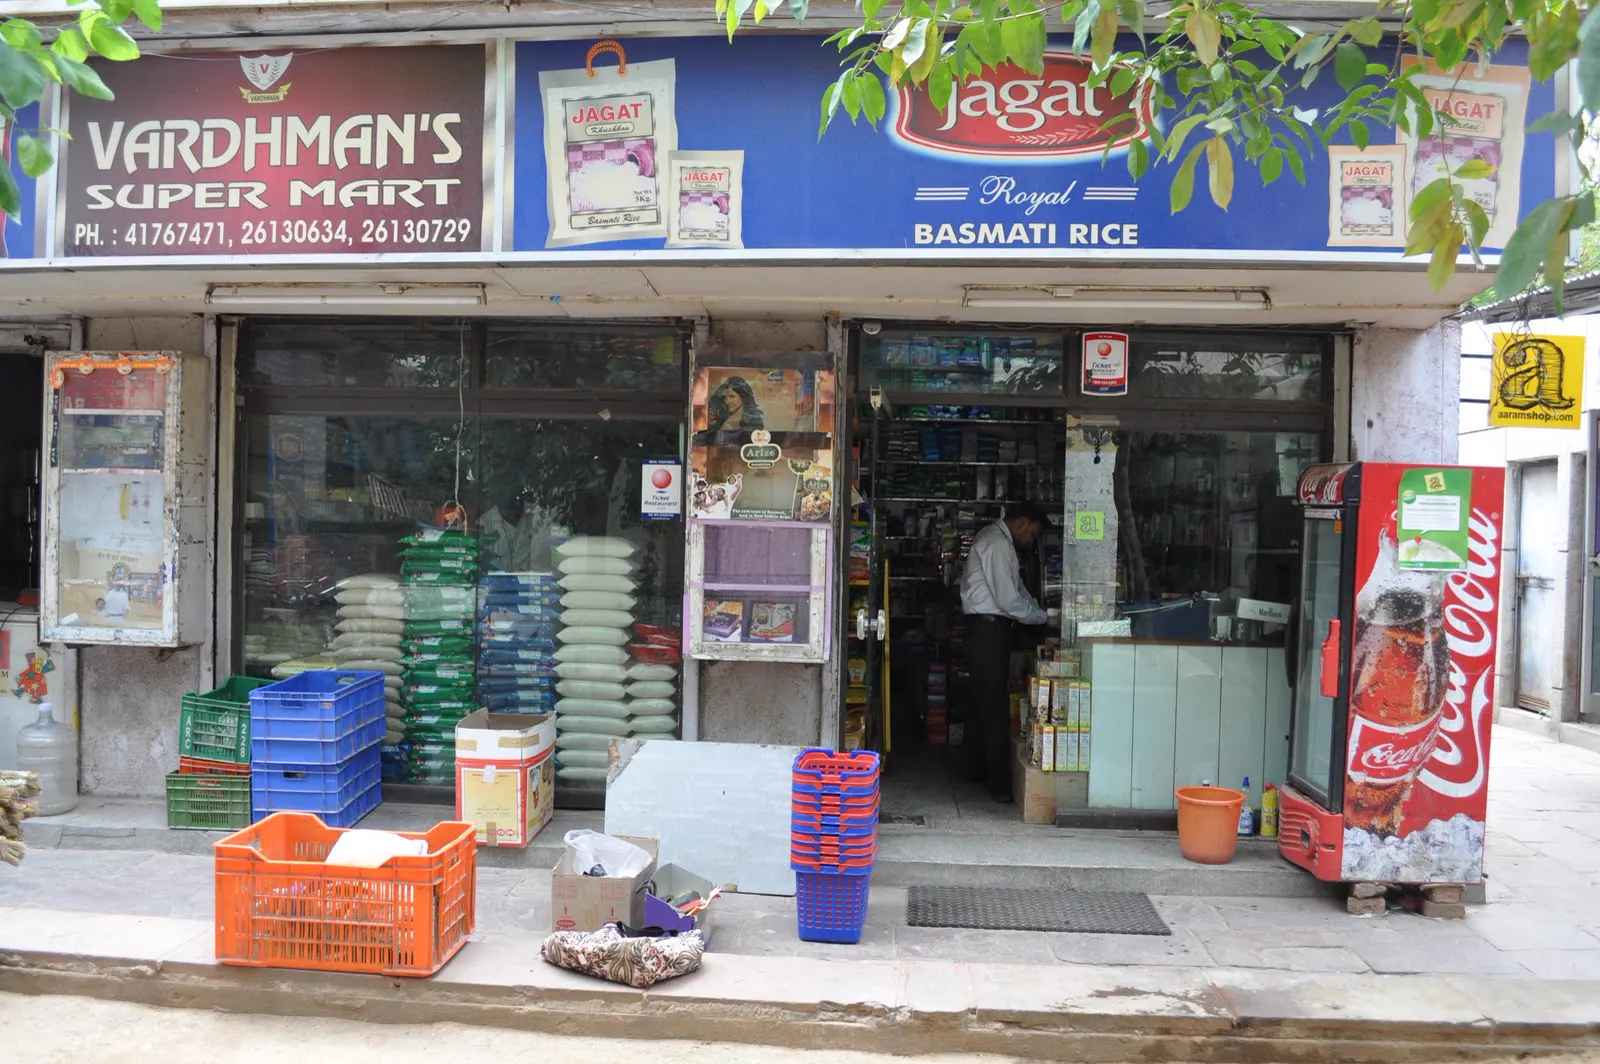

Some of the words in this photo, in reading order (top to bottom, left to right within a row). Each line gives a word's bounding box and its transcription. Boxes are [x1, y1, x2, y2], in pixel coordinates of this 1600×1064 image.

[259, 63, 270, 74] V
[250, 94, 280, 102] VARDHMAN
[572, 103, 643, 124] JAGAT
[590, 125, 630, 134] Khushboo
[86, 112, 464, 175] VARDHMAN'S
[684, 172, 725, 182] JAGAT
[1345, 166, 1386, 176] JAGAT
[86, 181, 269, 211] SUPER
[289, 177, 462, 209] MART
[979, 175, 1078, 216] Royal
[588, 215, 620, 225] Basmati
[623, 213, 640, 222] Rice
[125, 221, 233, 248] 41767471,
[241, 219, 354, 247] 26130634,
[361, 217, 471, 244] 26130729
[913, 223, 1056, 245] BASMATI
[1069, 223, 1139, 245] RICE
[1497, 410, 1574, 423] aaramshop.com
[746, 448, 776, 458] Arise
[184, 714, 192, 750] ARC
[239, 723, 247, 759] 228
